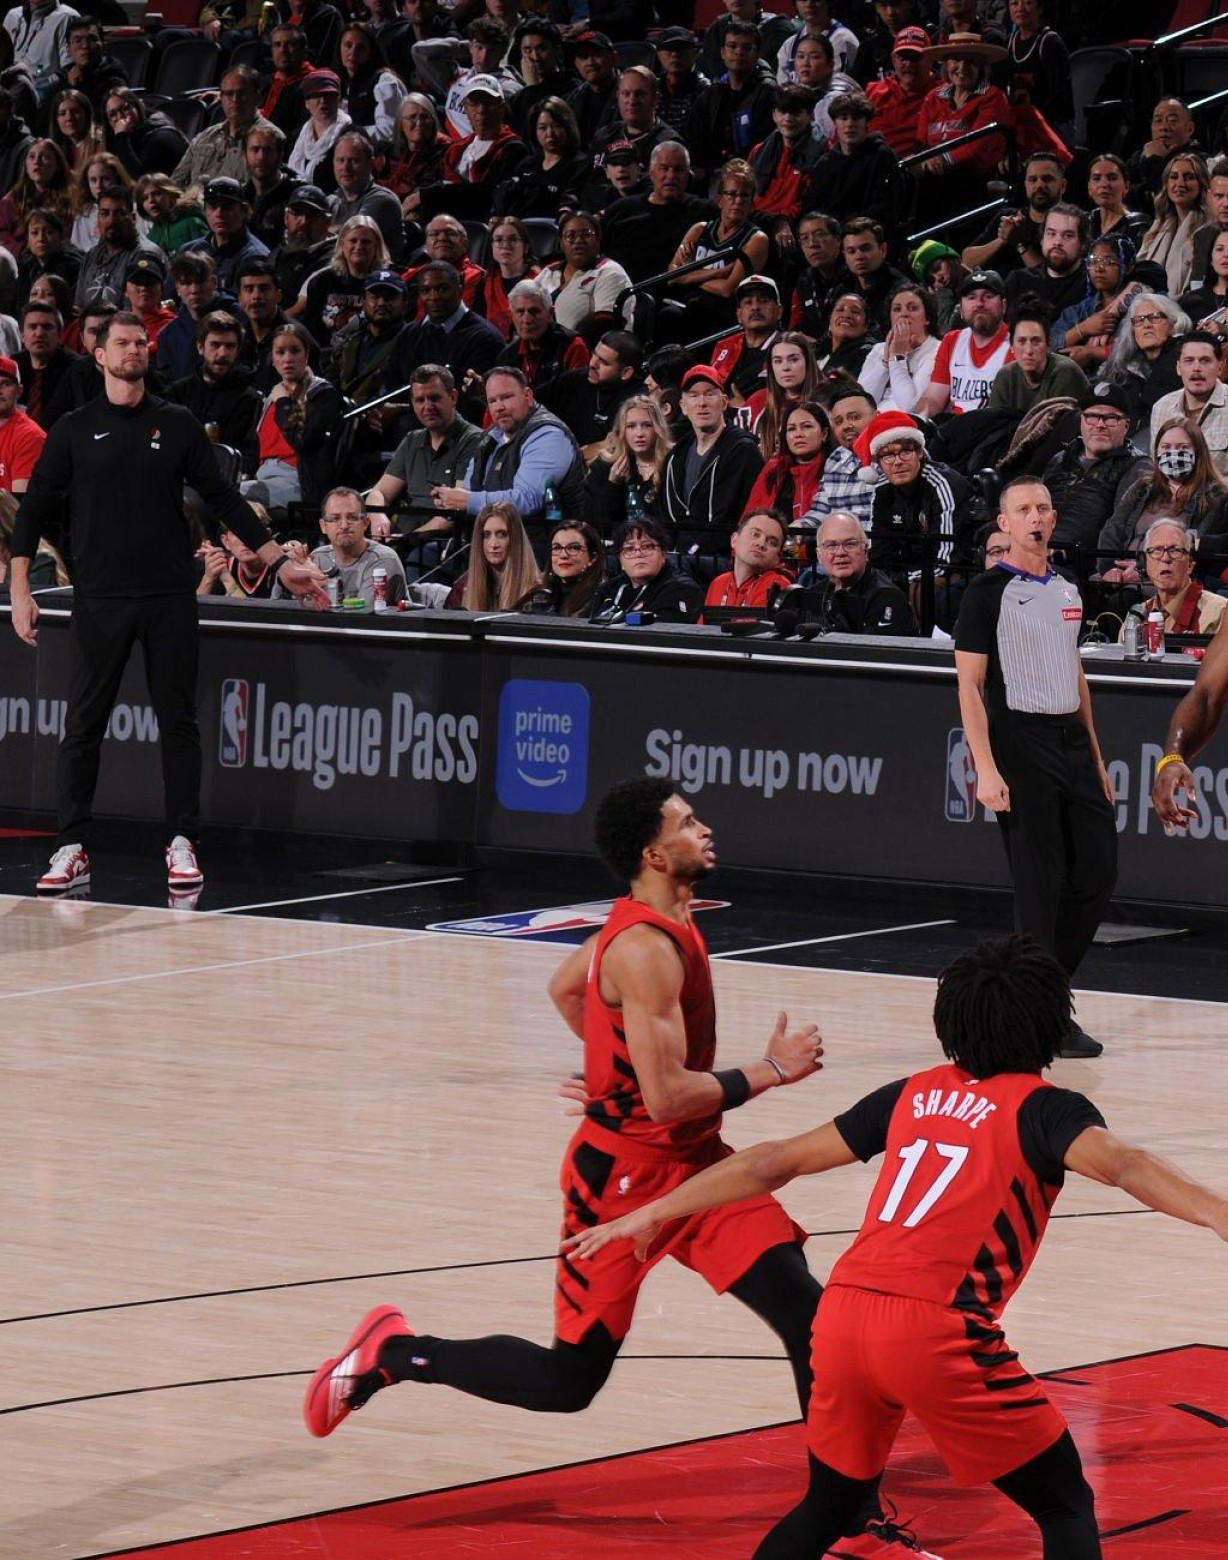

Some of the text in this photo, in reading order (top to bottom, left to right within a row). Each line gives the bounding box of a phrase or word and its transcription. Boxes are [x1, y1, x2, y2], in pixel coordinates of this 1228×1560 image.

[379, 271, 391, 280] P
[253, 683, 479, 790] League Pass
[515, 707, 572, 736] prime
[516, 738, 570, 763] video
[645, 728, 883, 798] Sign up now
[912, 1089, 997, 1129] SHARPE
[878, 1138, 970, 1228] 17
